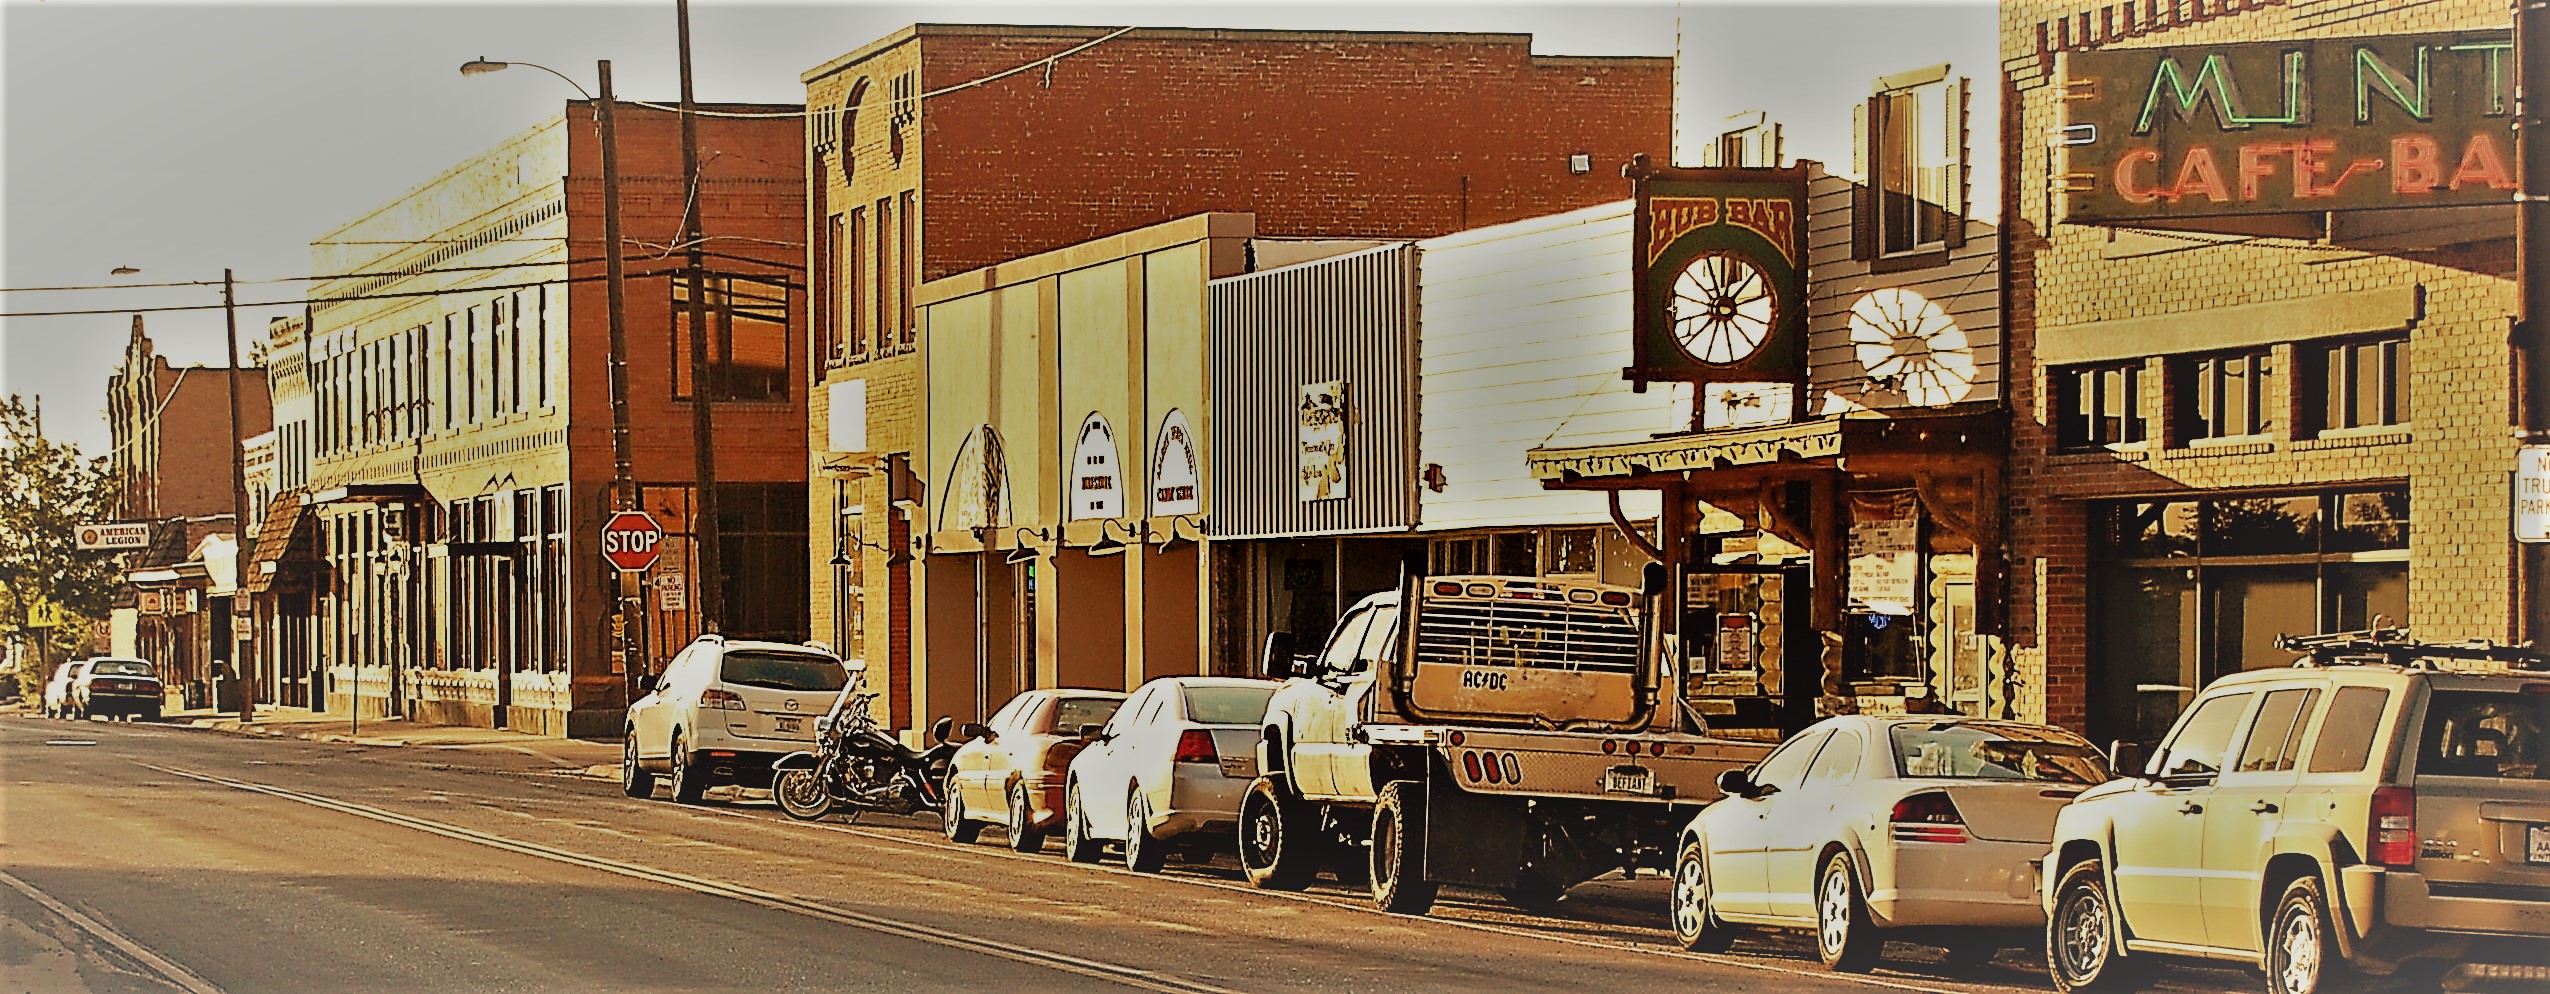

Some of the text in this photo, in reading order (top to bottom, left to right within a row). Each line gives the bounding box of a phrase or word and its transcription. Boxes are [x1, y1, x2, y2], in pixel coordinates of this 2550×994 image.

[1648, 197, 1795, 269] HUB BAR
[101, 528, 146, 536] AMERICAN
[106, 537, 141, 545] LEGION
[606, 530, 658, 553] STOP
